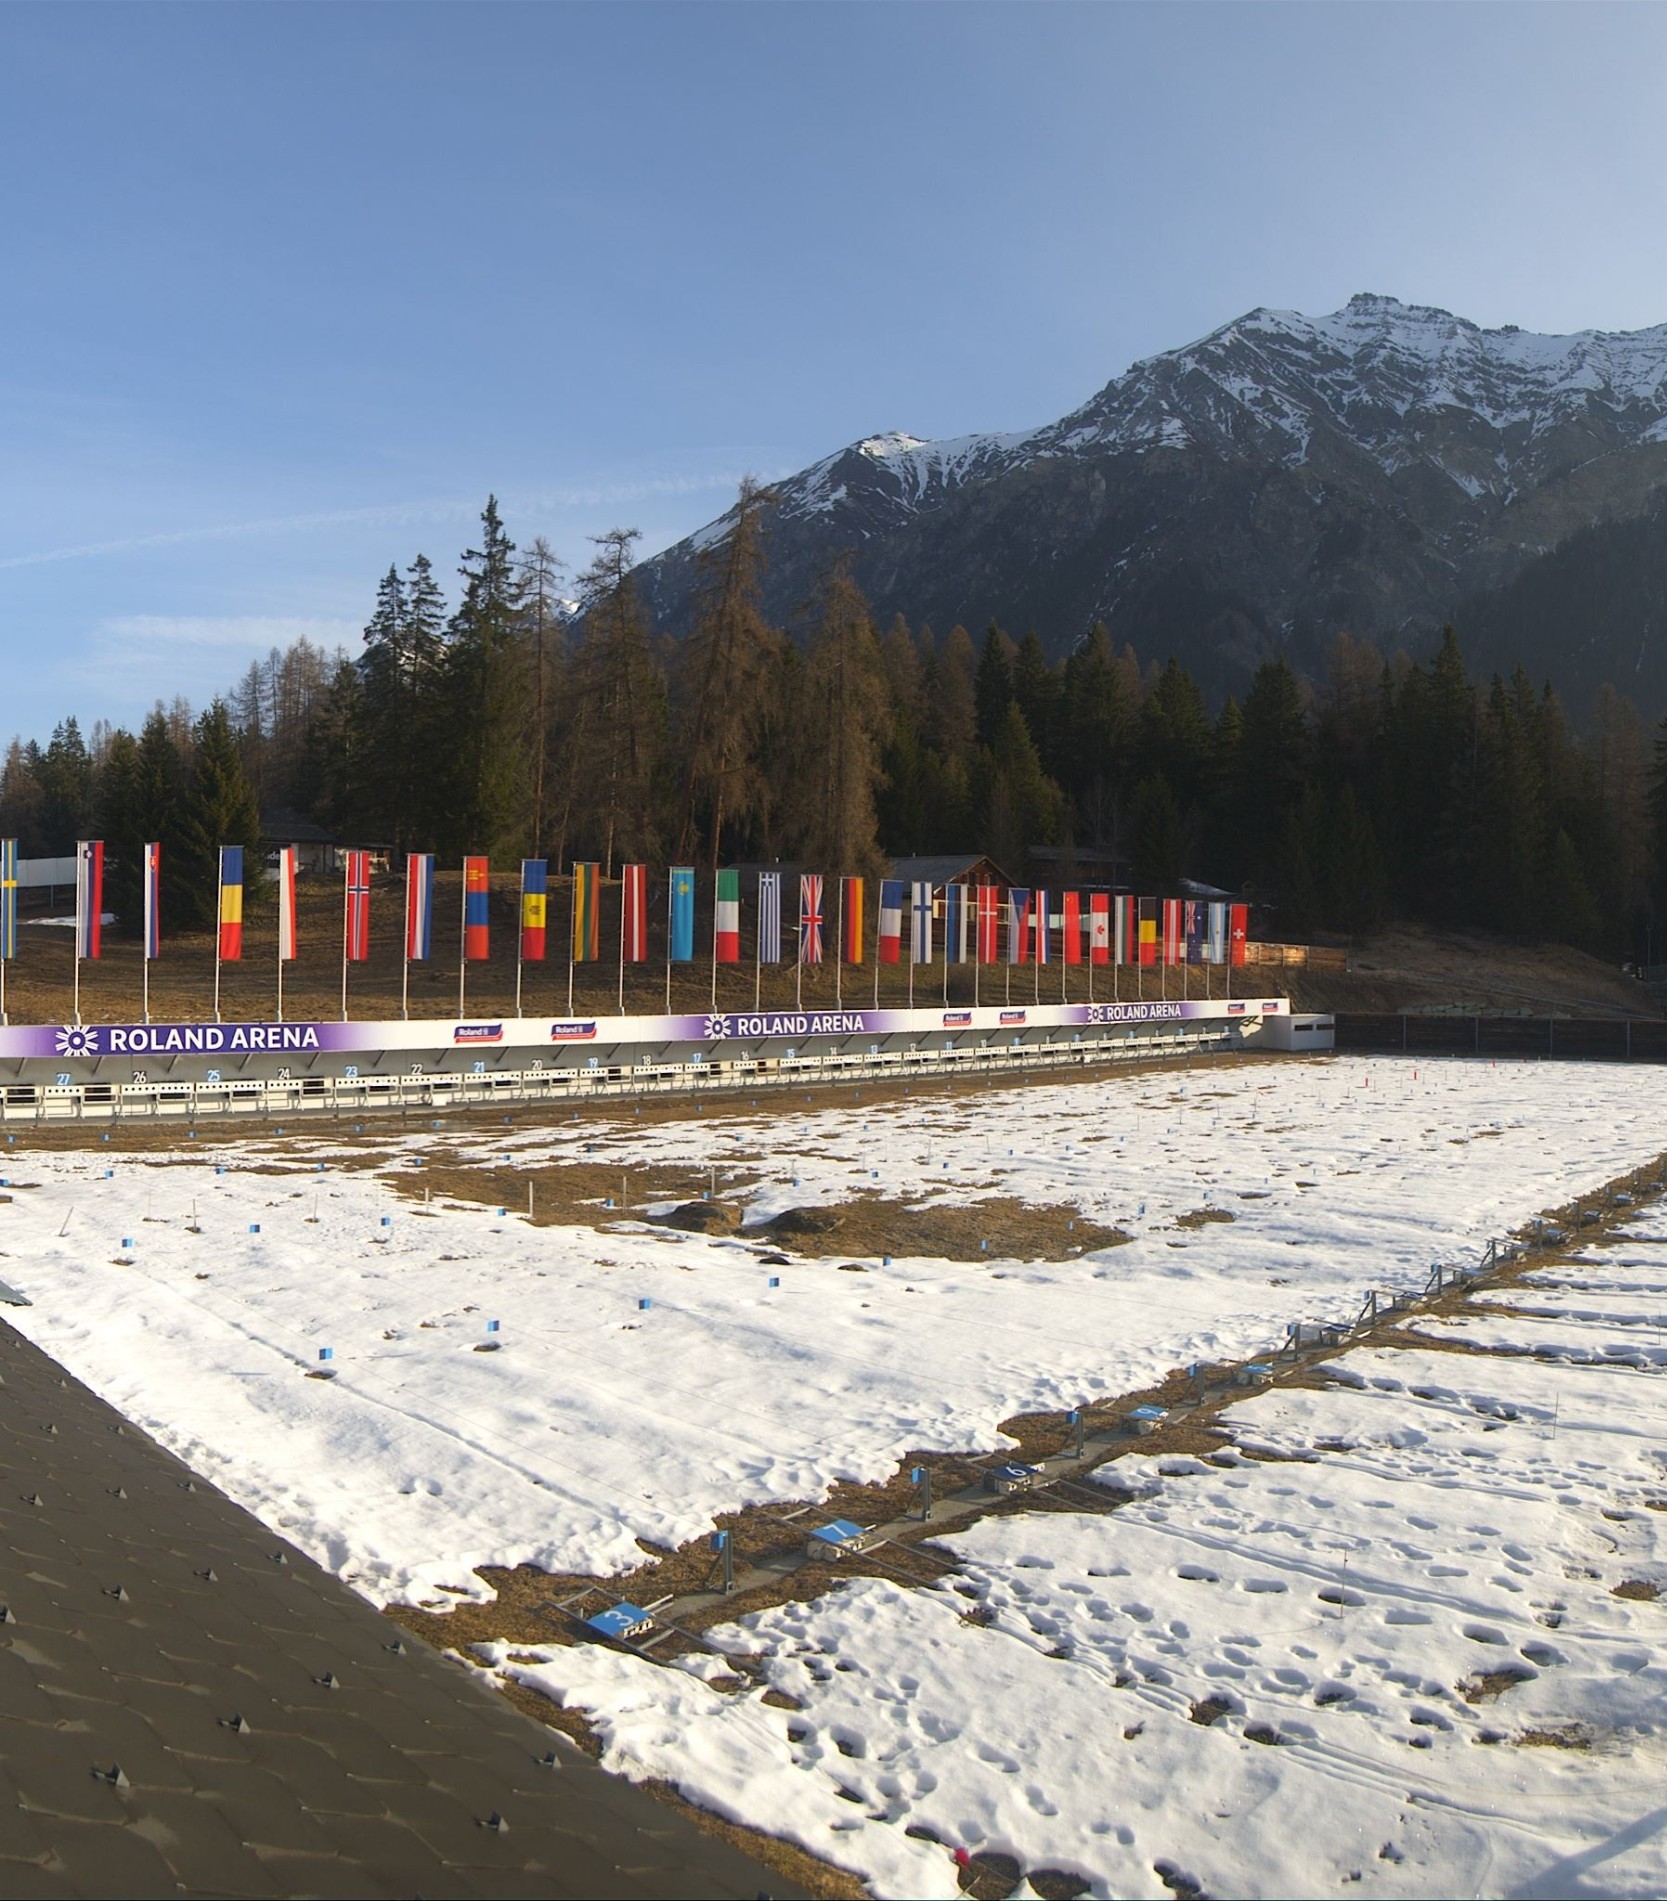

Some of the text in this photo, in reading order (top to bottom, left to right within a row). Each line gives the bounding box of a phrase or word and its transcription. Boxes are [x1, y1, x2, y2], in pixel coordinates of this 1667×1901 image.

[1107, 1004, 1182, 1020] ROLAND ARENA
[555, 1024, 578, 1034] Roland
[737, 1015, 865, 1036] ROLAND ARENA
[458, 1027, 483, 1037] Roland
[110, 1026, 320, 1051] ROLAND ARENA
[692, 1053, 702, 1064] 17
[741, 1051, 750, 1061] 16
[787, 1049, 796, 1059] 15
[531, 1060, 543, 1071] 20
[588, 1058, 598, 1069] 19
[642, 1055, 652, 1067] 18
[345, 1066, 358, 1078] 23
[411, 1064, 423, 1076] 22
[473, 1062, 485, 1073] 21
[57, 1073, 71, 1086] 27
[133, 1071, 147, 1084] 26
[207, 1069, 221, 1082] 25
[278, 1068, 291, 1080] 24
[604, 1610, 634, 1627] 3
